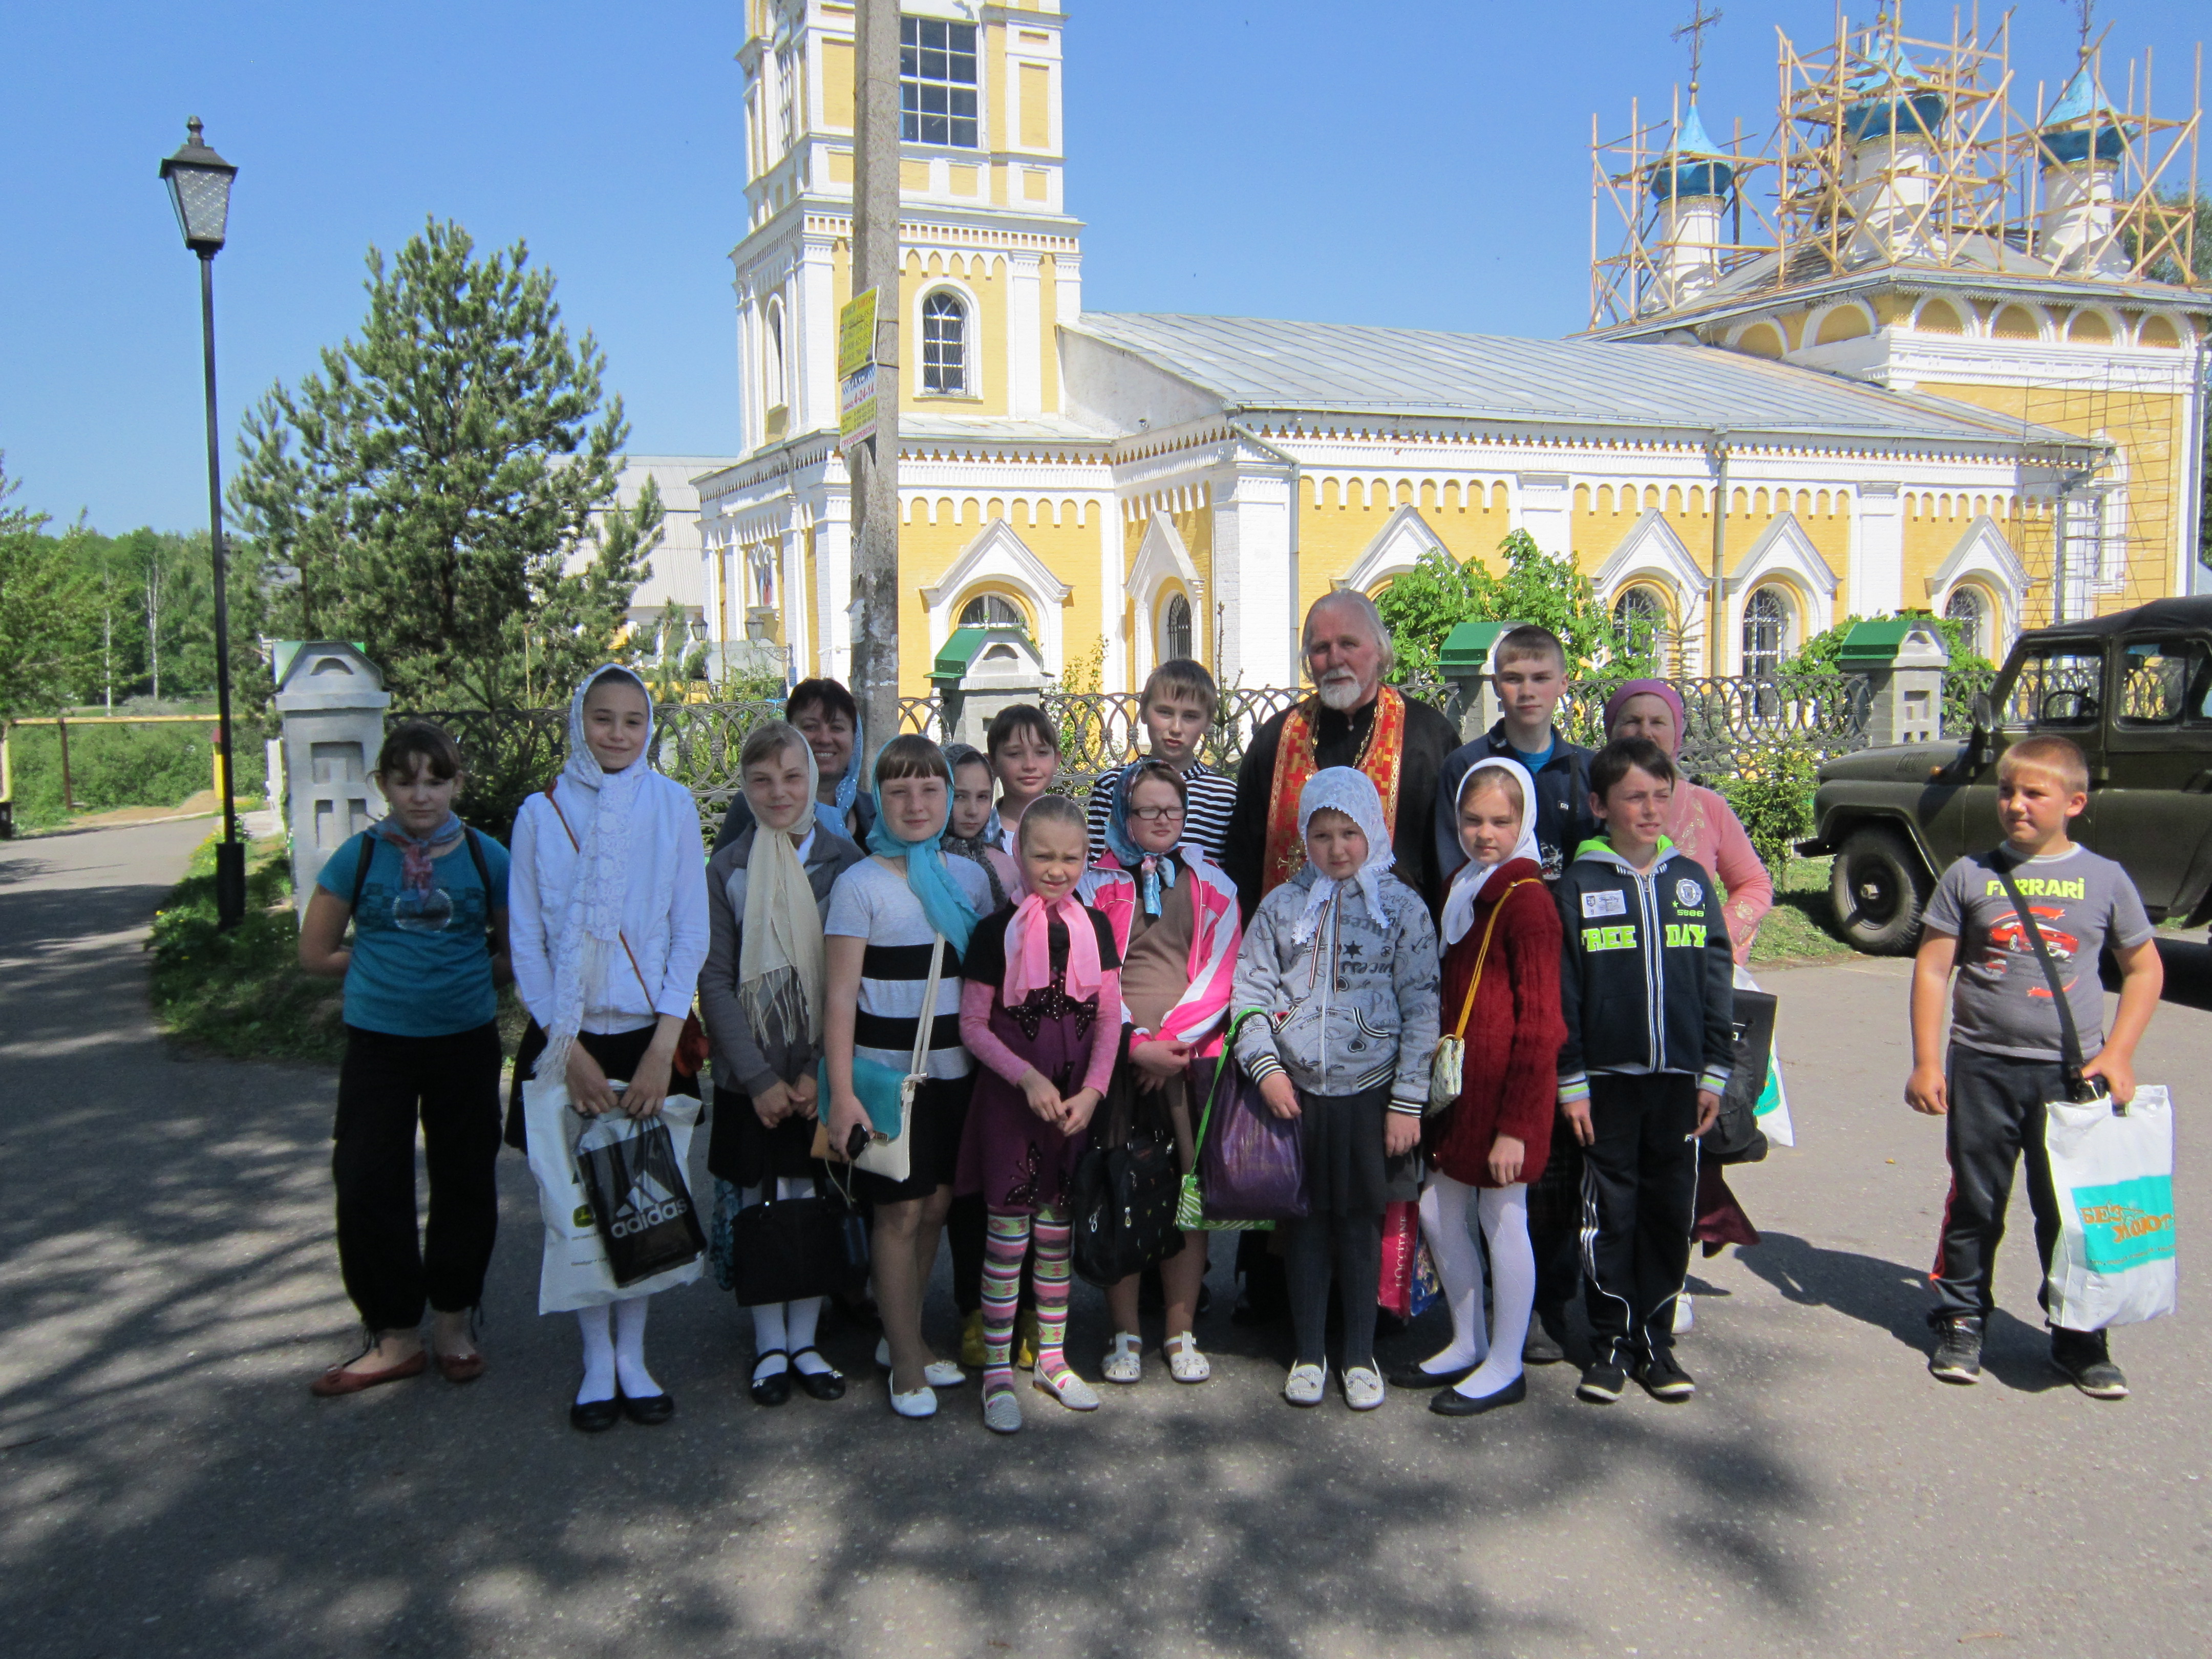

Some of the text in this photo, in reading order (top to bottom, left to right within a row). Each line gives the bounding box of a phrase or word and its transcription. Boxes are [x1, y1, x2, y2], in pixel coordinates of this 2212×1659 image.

[849, 370, 868, 391] ТАКСИ
[854, 381, 874, 405] 4-24-14
[1665, 923, 1707, 948] DAY
[611, 1198, 688, 1238] adidas
[2080, 1205, 2123, 1224] БЕЗ
